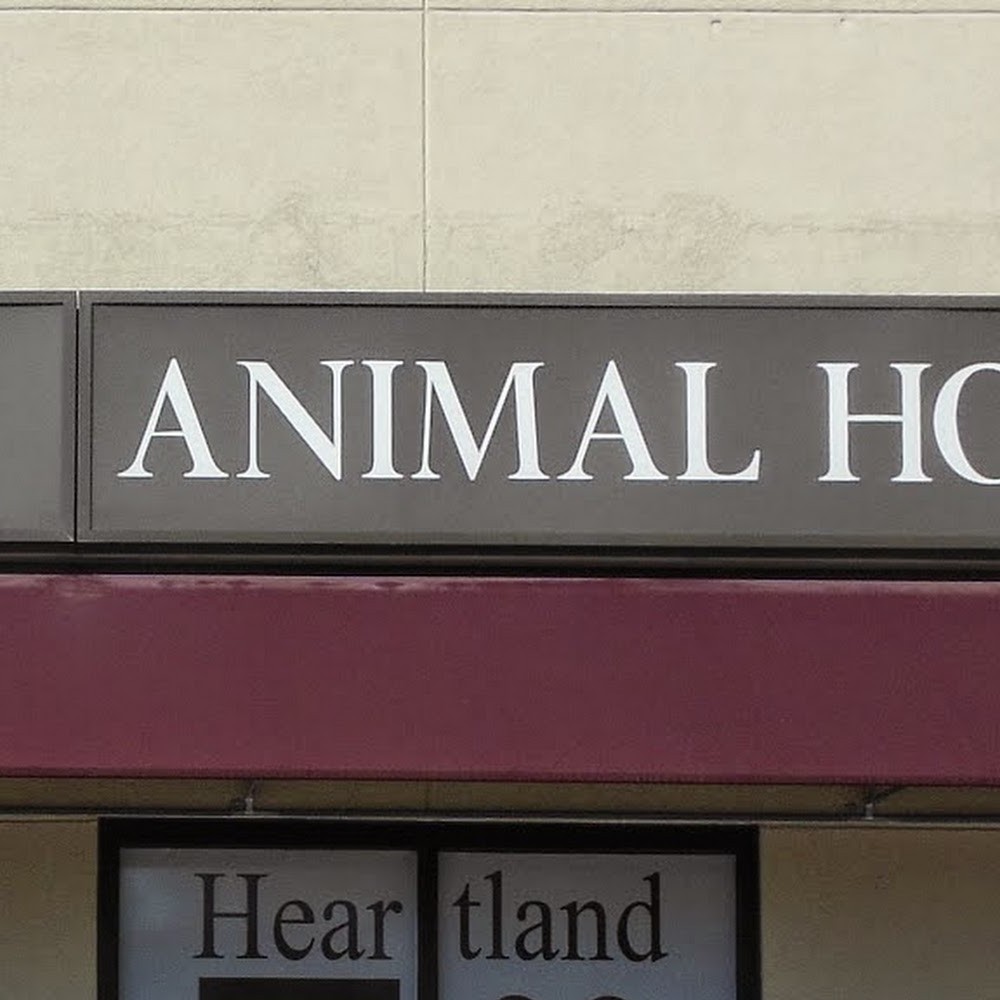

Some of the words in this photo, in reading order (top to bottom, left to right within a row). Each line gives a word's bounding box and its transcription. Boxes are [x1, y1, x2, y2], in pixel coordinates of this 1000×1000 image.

[117, 358, 762, 481] ANIMAL
[816, 362, 1000, 485] HO
[192, 872, 404, 962] Hear
[452, 867, 670, 963] tland
